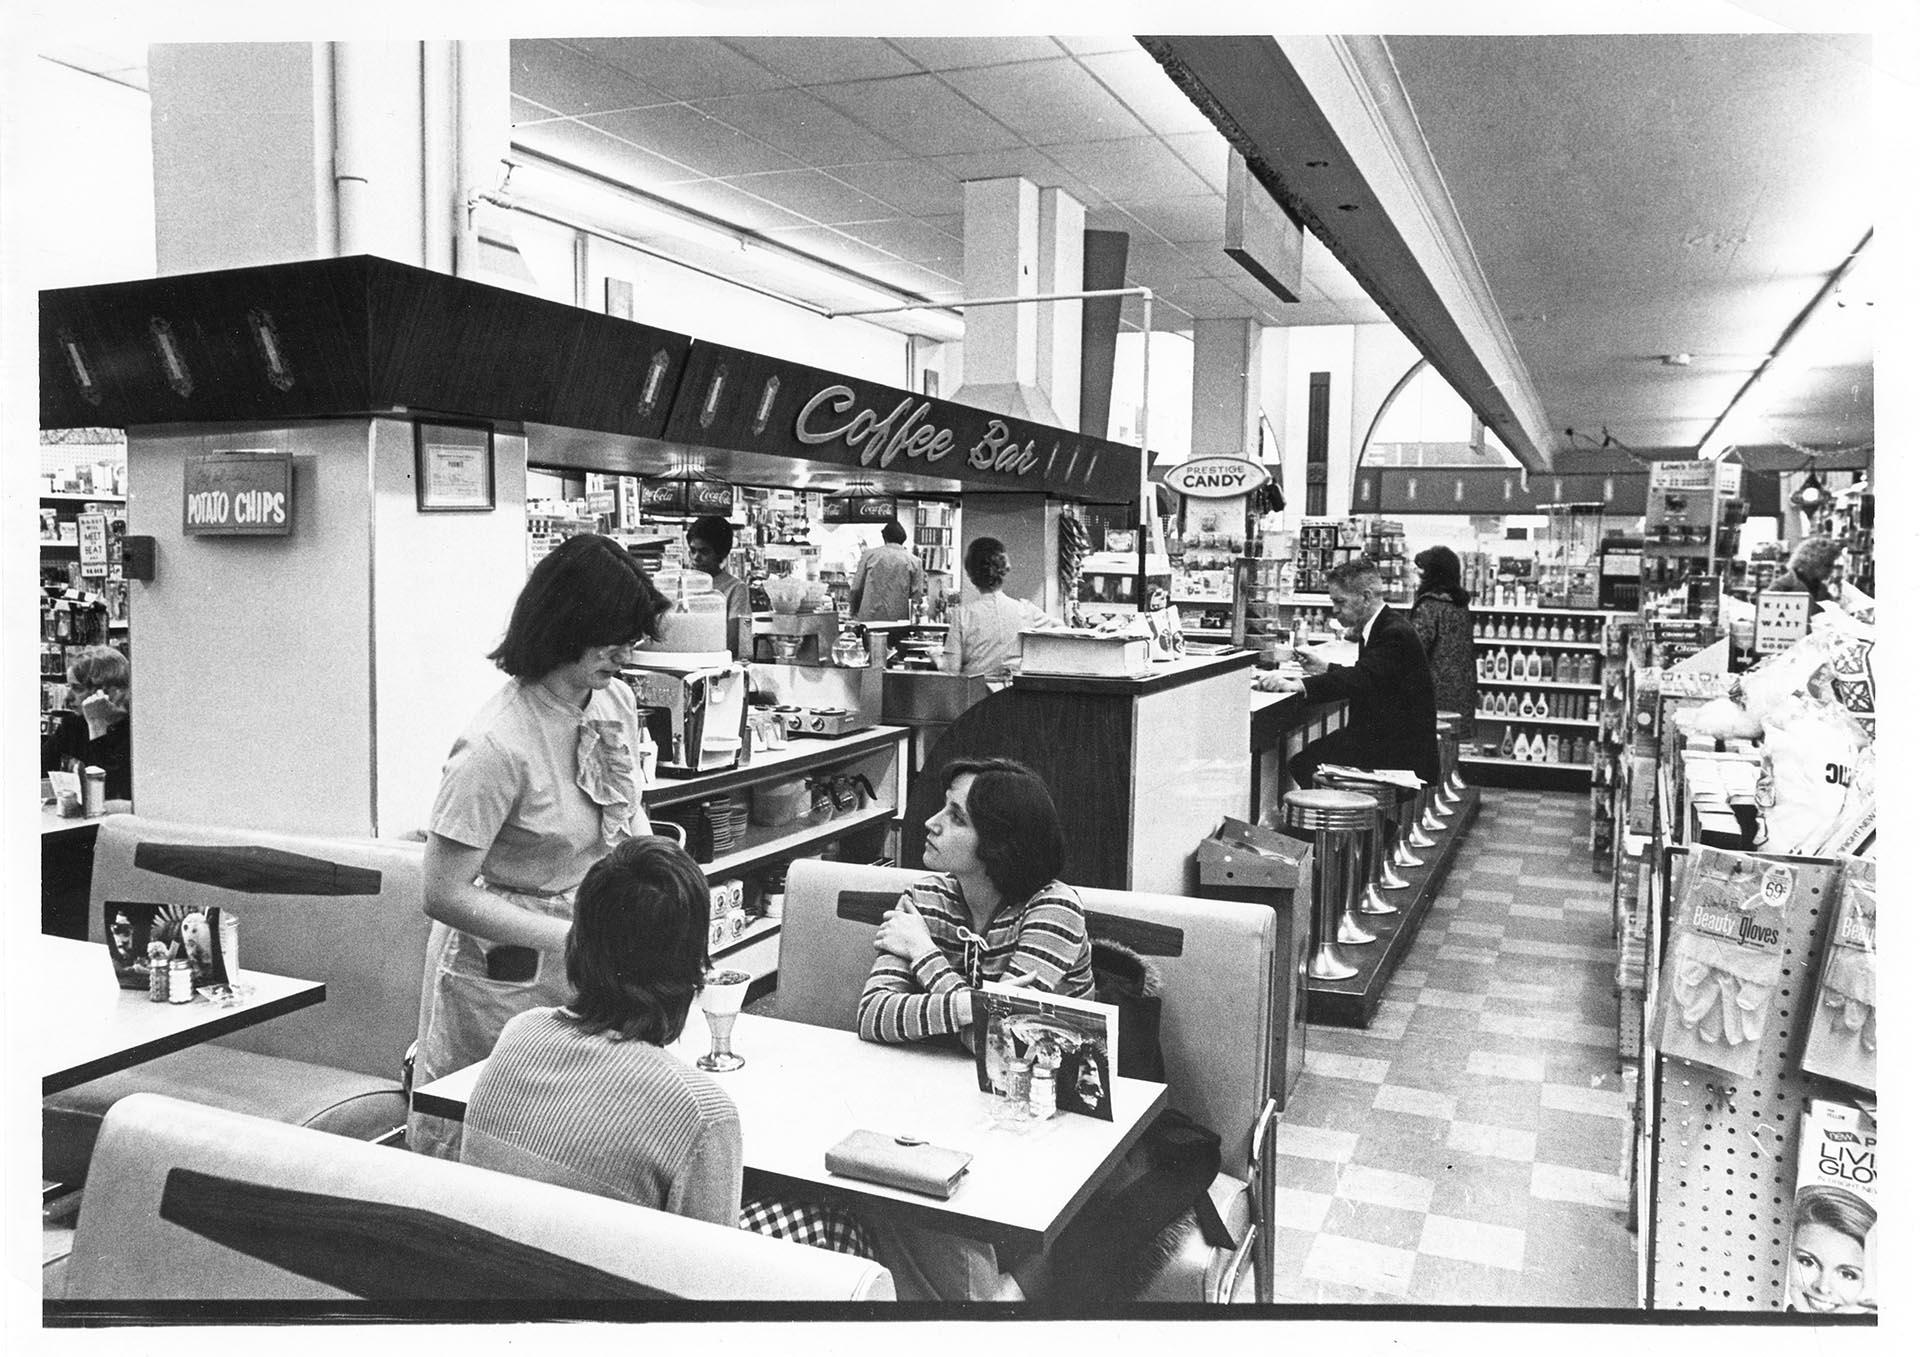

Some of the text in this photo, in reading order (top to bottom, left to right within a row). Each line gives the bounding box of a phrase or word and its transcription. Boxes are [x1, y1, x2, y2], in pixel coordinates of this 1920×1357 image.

[796, 385, 1039, 476] Coffee Bar
[1186, 464, 1245, 475] PRESTIGE
[1183, 474, 1246, 488] CANDY
[187, 489, 286, 524] POTATO CHIPS
[1763, 601, 1801, 610] KILL
[1778, 611, 1786, 619] A
[1761, 620, 1801, 629] WATT
[1693, 905, 1736, 935] Beauty
[1737, 915, 1780, 946] gloves
